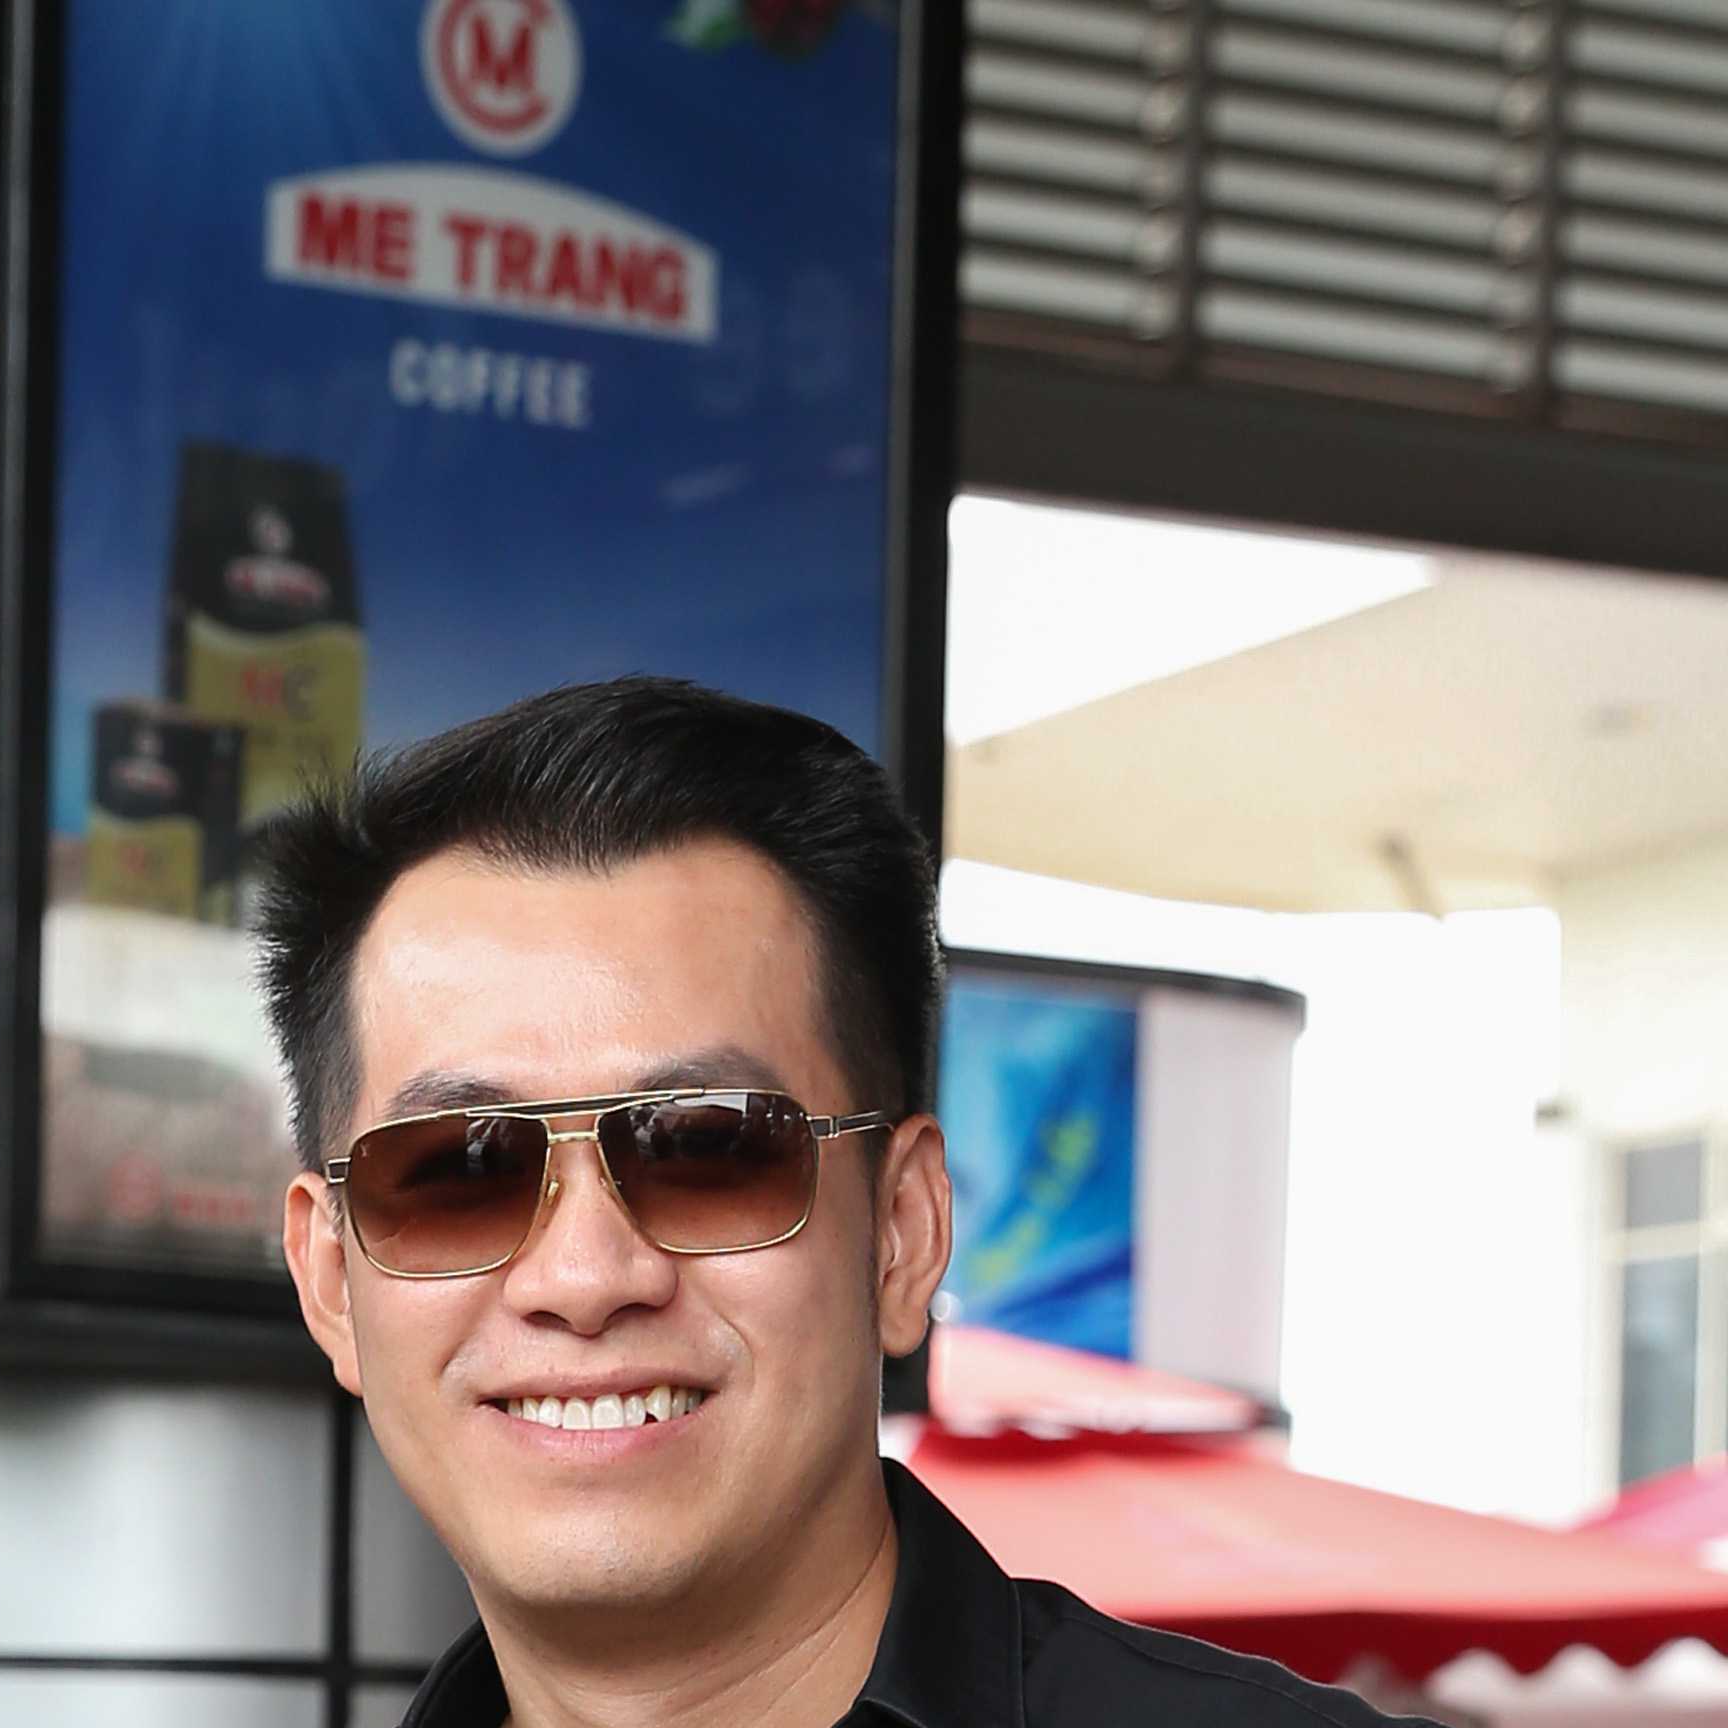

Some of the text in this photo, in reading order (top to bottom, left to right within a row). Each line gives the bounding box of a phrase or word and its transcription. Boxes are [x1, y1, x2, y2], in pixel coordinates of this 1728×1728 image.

[294, 187, 690, 330] ME TRANG
[390, 338, 588, 428] COFFEE
